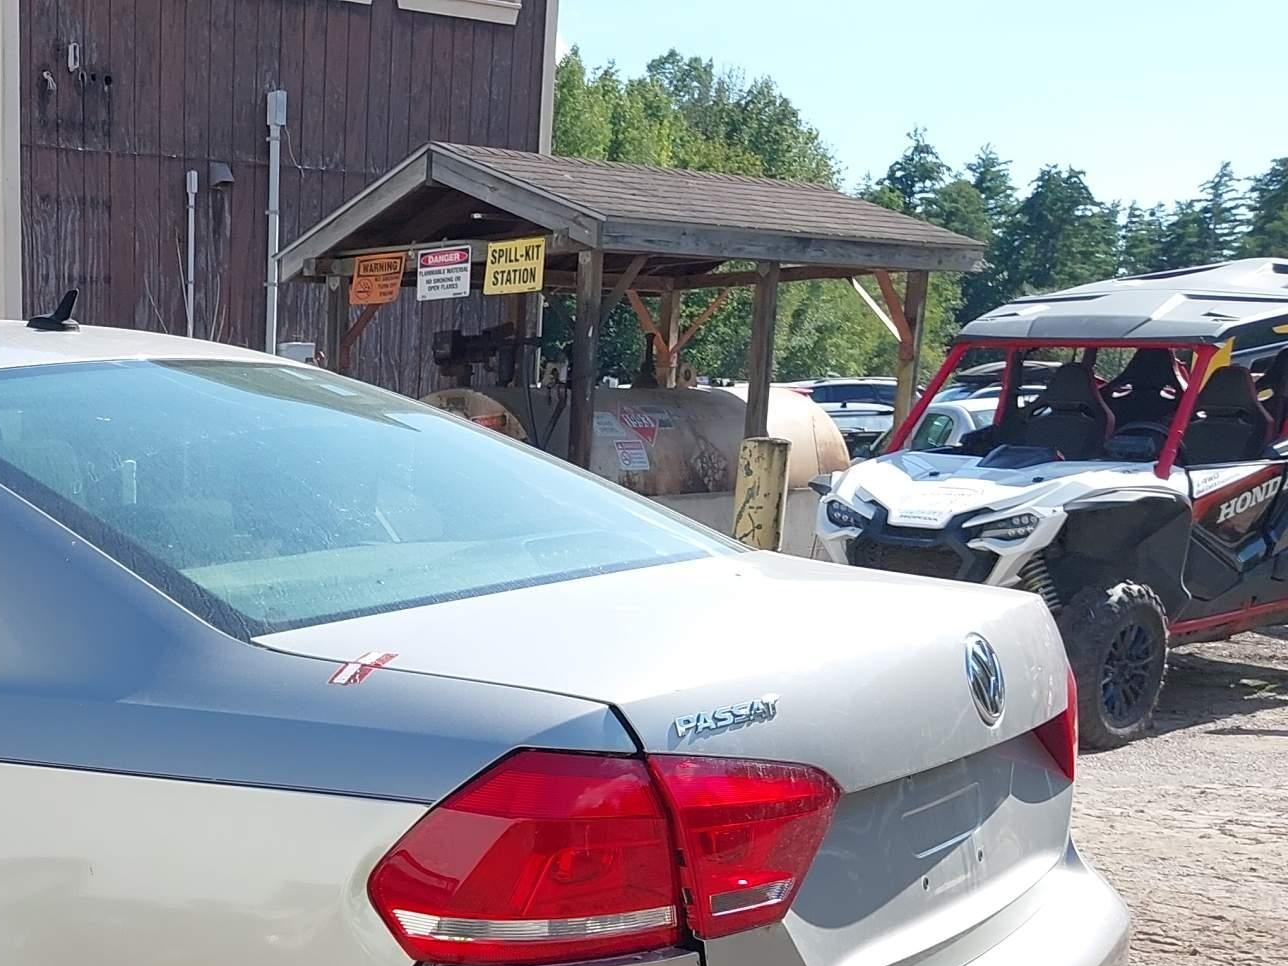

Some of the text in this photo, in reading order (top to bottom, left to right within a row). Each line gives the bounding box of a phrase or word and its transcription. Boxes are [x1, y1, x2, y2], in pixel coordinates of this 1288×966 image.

[428, 253, 460, 264] DANGER
[490, 244, 541, 264] SPILL-KIT
[362, 261, 398, 273] WARNING
[433, 276, 453, 284] SMOKING
[492, 267, 536, 286] STATION
[675, 693, 779, 738] PASSAT
